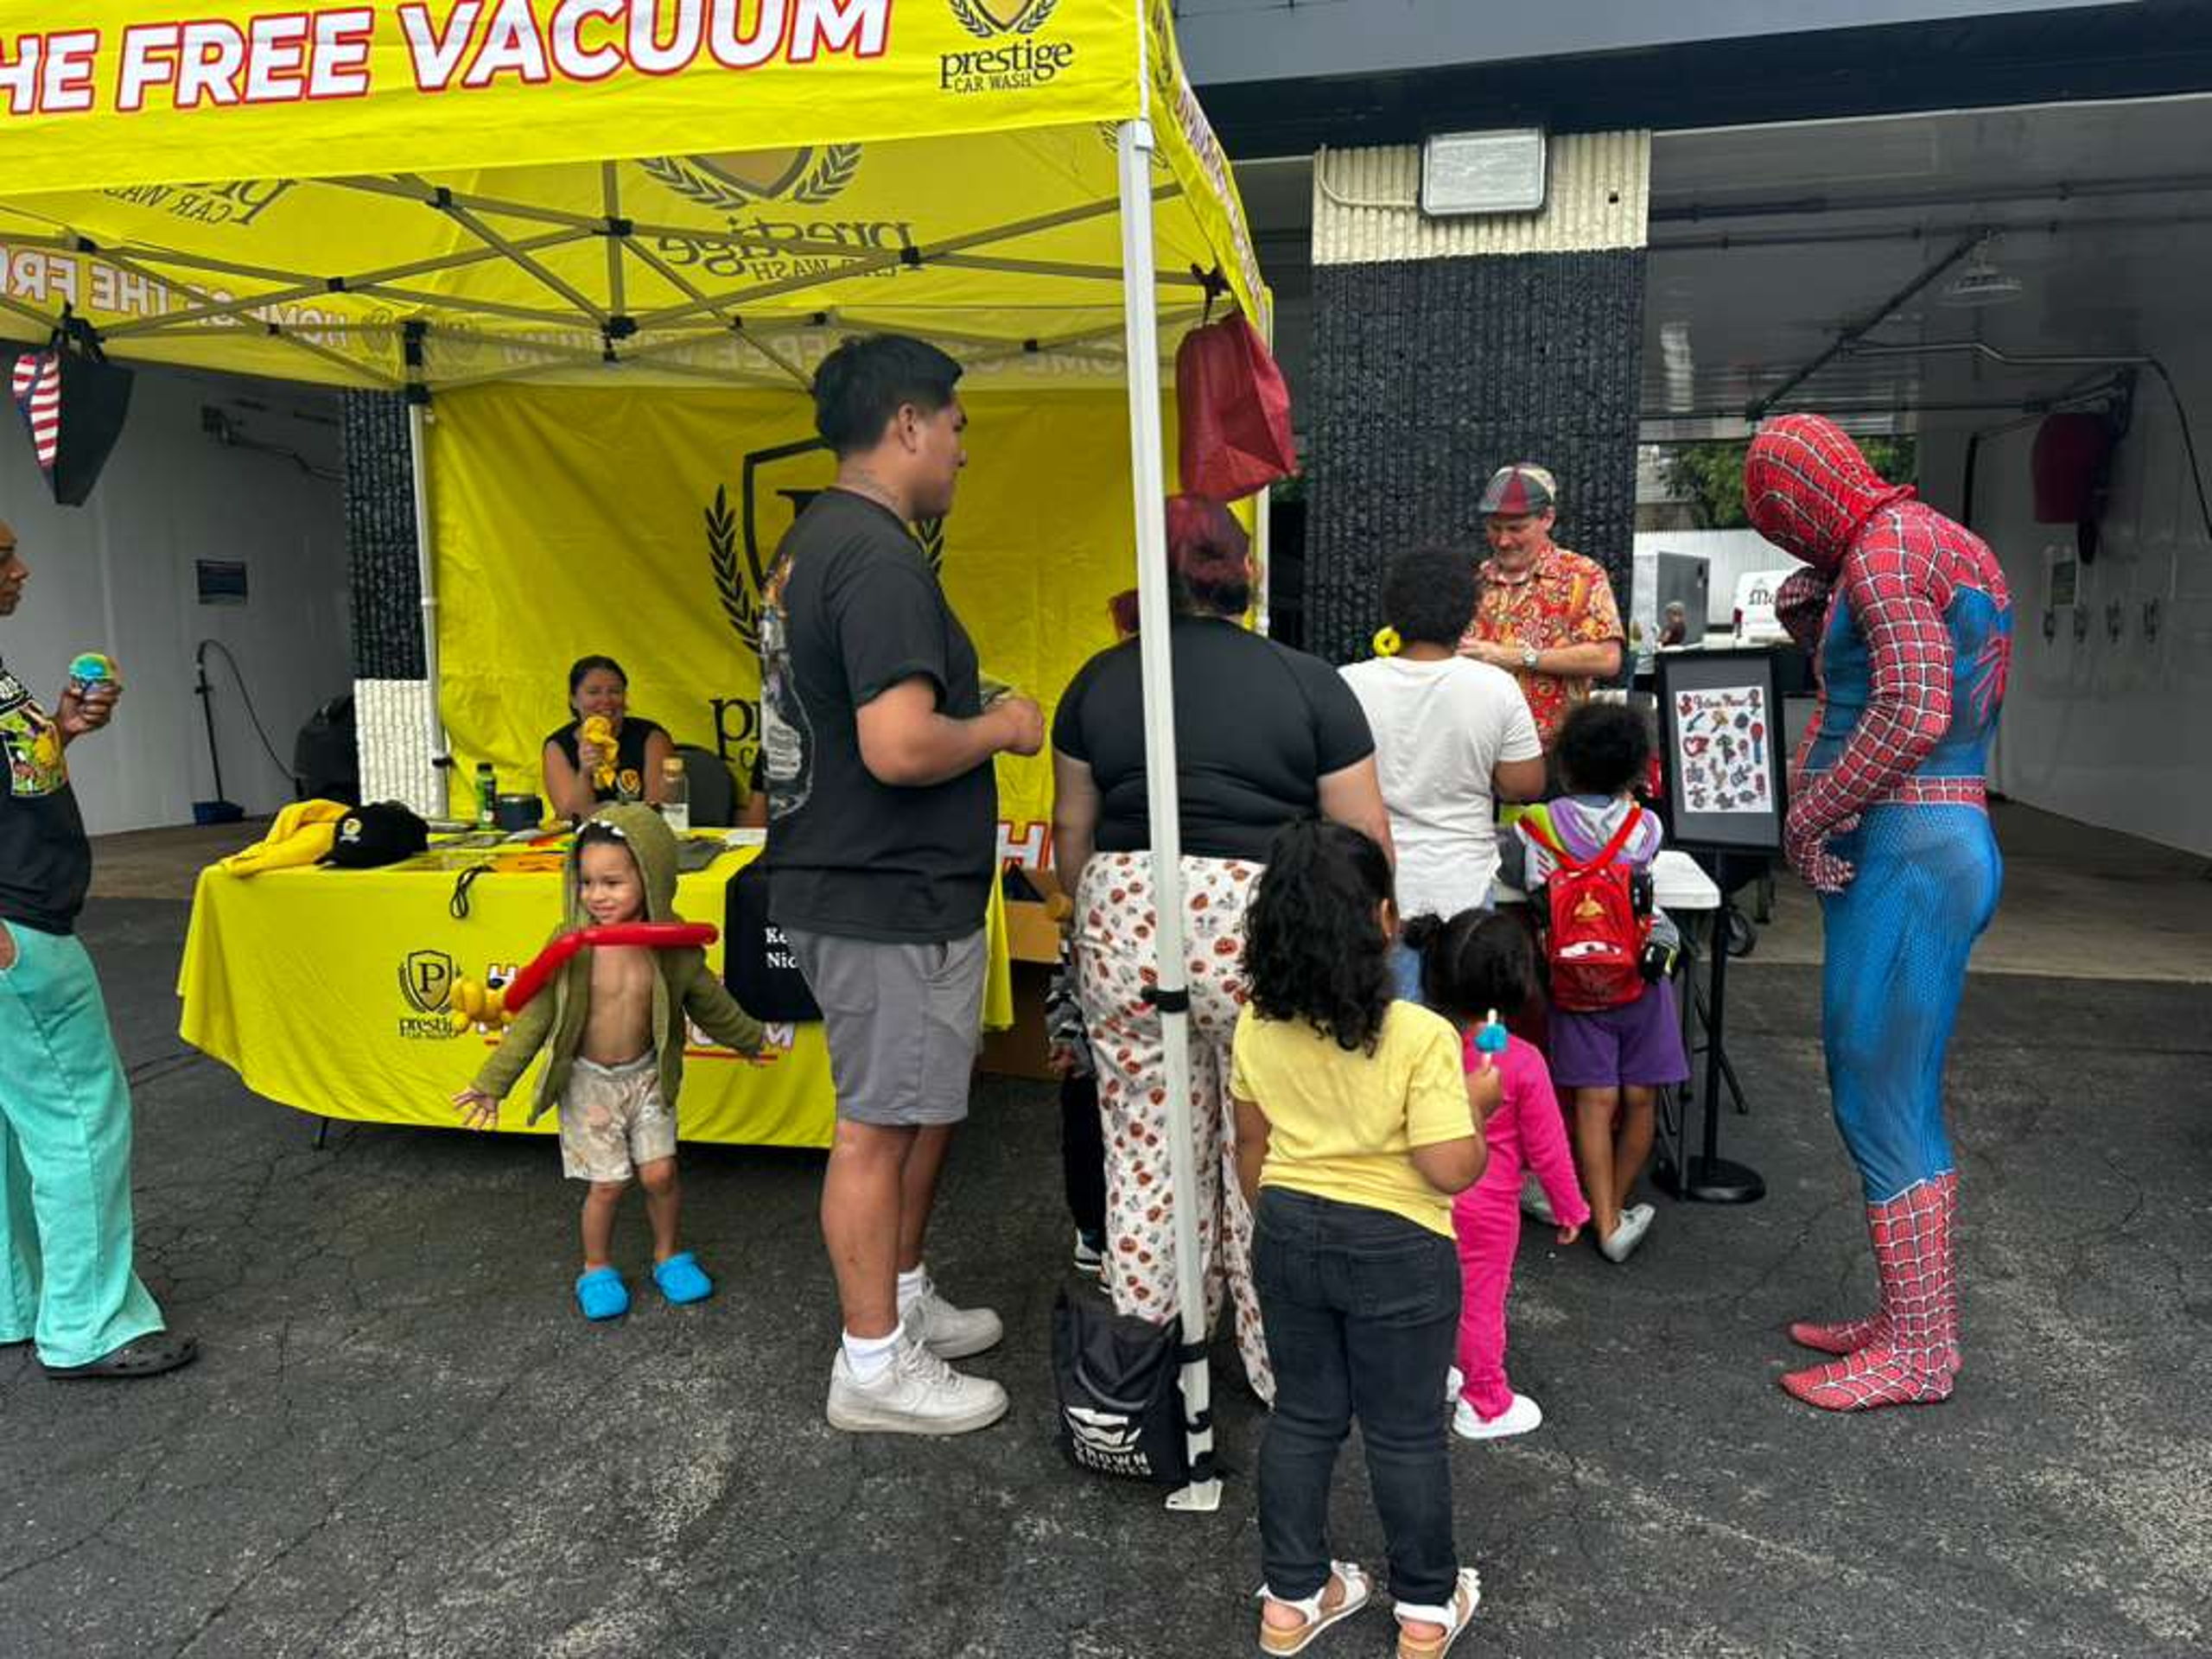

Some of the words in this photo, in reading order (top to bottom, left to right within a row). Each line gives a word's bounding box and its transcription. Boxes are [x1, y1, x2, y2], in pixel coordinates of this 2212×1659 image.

[116, 7, 375, 111] FREE
[397, 0, 891, 91] VACUUM
[939, 38, 1073, 90] prestige
[954, 74, 985, 93] CAR
[989, 73, 1033, 91] WASH
[765, 926, 788, 944] Ke
[766, 951, 798, 969] Nic
[418, 963, 446, 993] P
